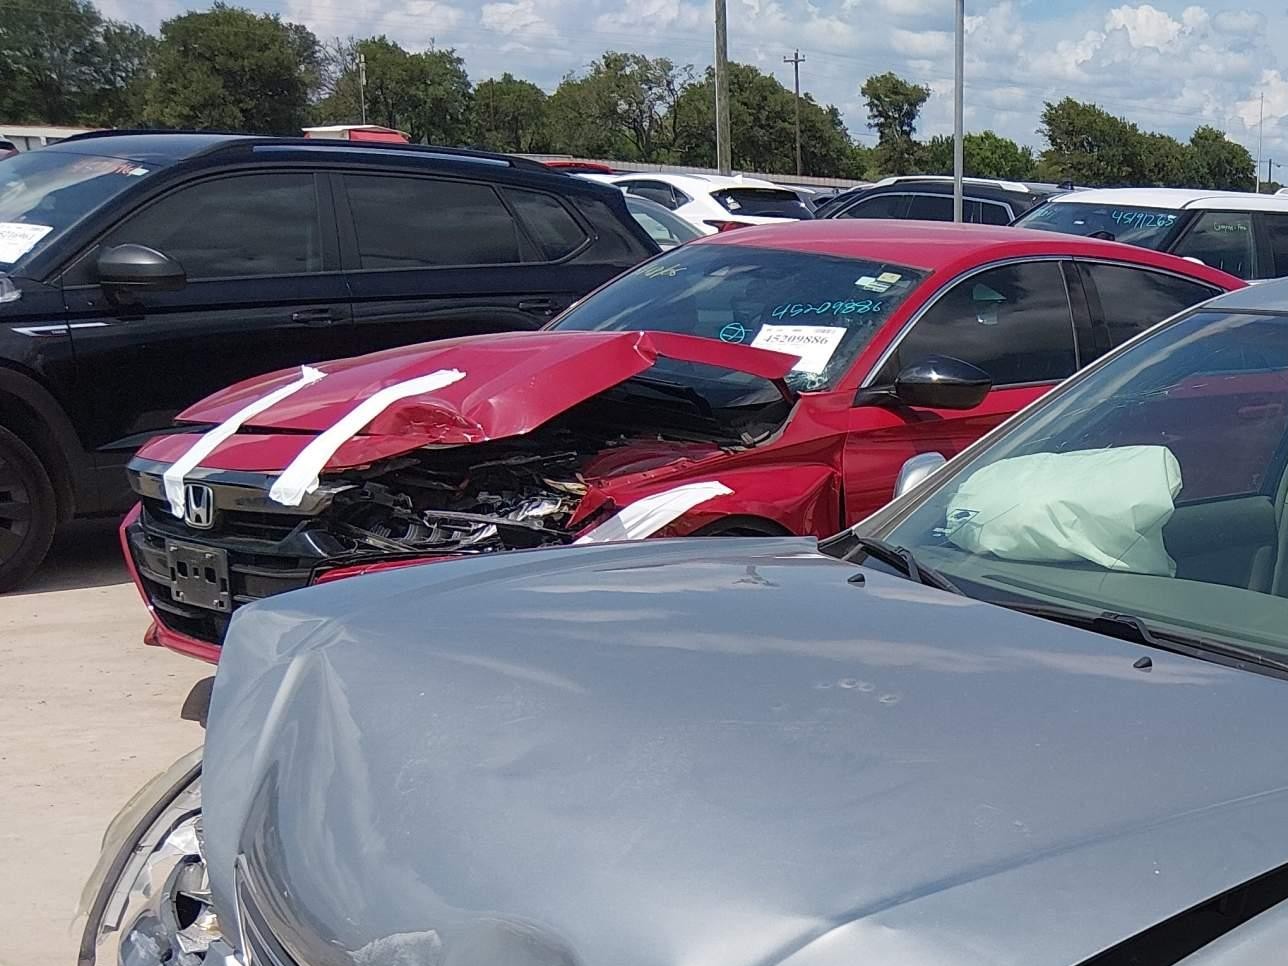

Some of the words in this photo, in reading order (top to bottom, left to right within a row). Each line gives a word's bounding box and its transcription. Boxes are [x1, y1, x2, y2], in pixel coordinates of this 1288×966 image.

[1112, 210, 1177, 230] 45191265
[771, 300, 882, 320] 45209886
[763, 333, 829, 345] 45209886
